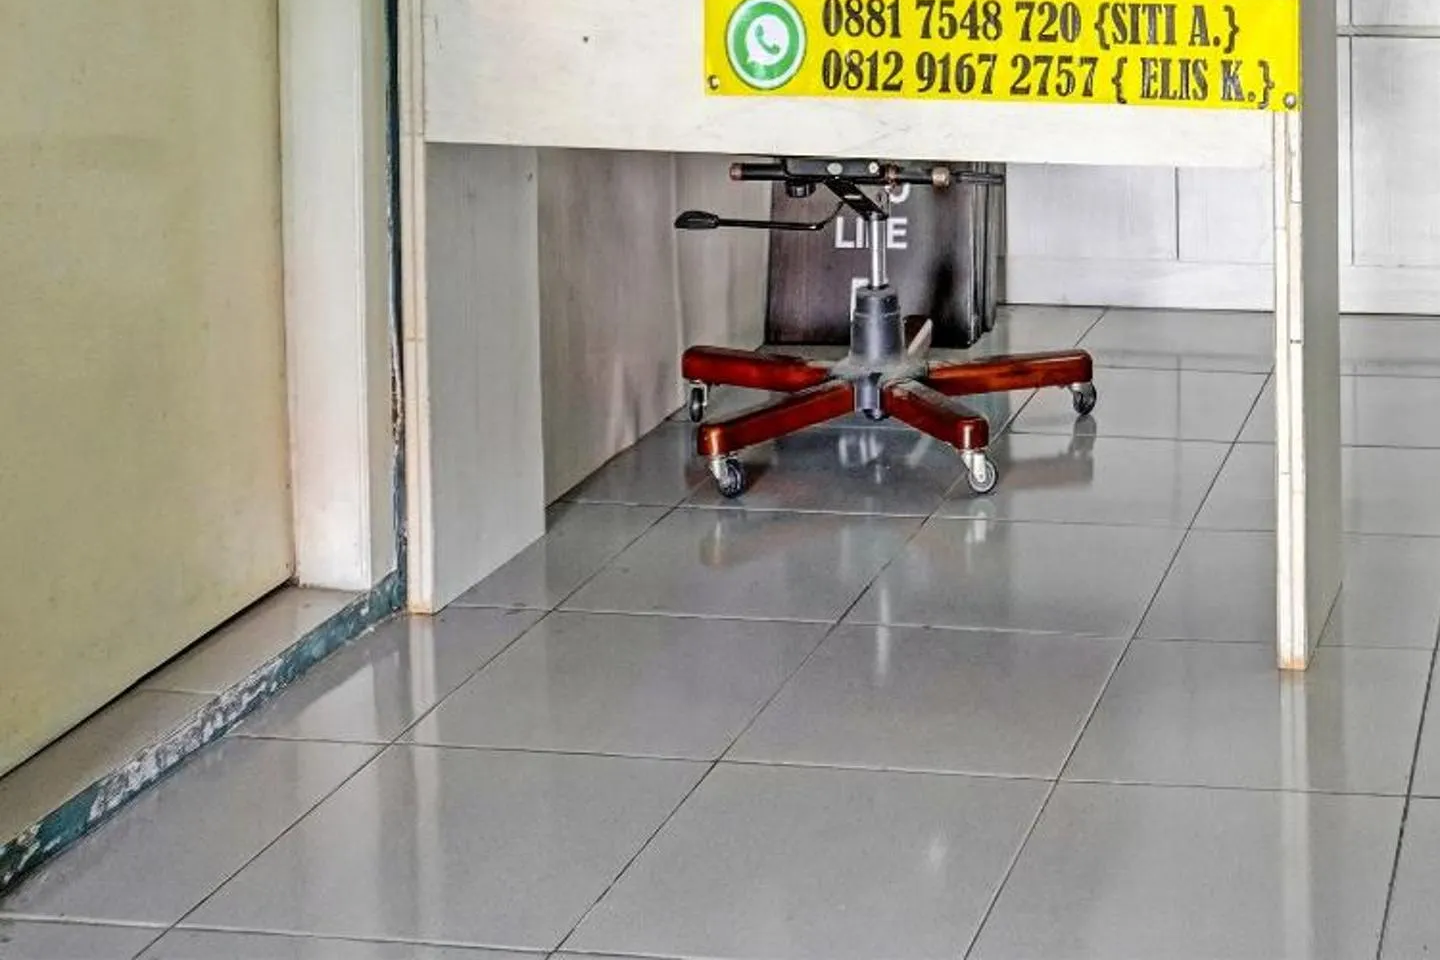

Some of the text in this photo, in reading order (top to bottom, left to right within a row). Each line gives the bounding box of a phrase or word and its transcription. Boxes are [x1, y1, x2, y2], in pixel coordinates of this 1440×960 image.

[915, 0, 1003, 41] 7548
[1015, 1, 1082, 43] 720
[822, 48, 904, 92] 0812
[916, 51, 998, 94] 9167
[1010, 54, 1099, 97] 2757
[1140, 56, 1209, 101] ELIS
[835, 217, 908, 248] LIE
